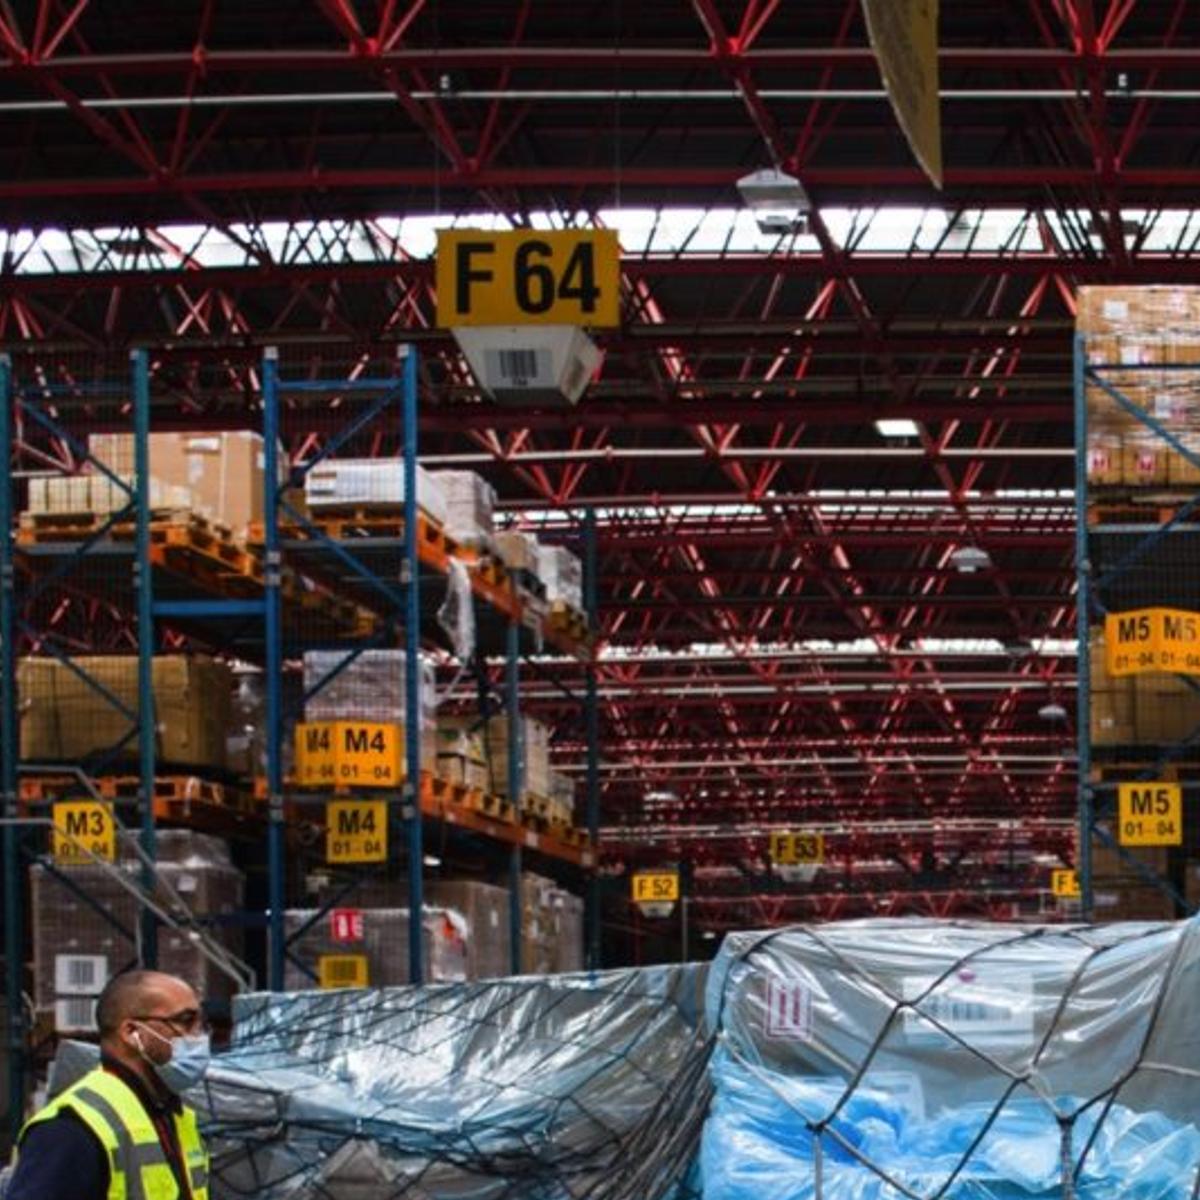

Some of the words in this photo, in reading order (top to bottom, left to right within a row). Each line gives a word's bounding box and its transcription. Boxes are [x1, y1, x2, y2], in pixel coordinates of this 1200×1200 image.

[457, 243, 495, 314] F
[514, 240, 601, 315] 64
[1119, 616, 1150, 643] M5
[1164, 615, 1196, 642] M5
[345, 728, 385, 752] M4
[1131, 789, 1170, 815] M5
[66, 811, 105, 837] M3
[338, 809, 375, 835] M4
[776, 838, 787, 857] F
[639, 881, 648, 896] F
[653, 879, 673, 896] 52
[1058, 874, 1068, 892] F
